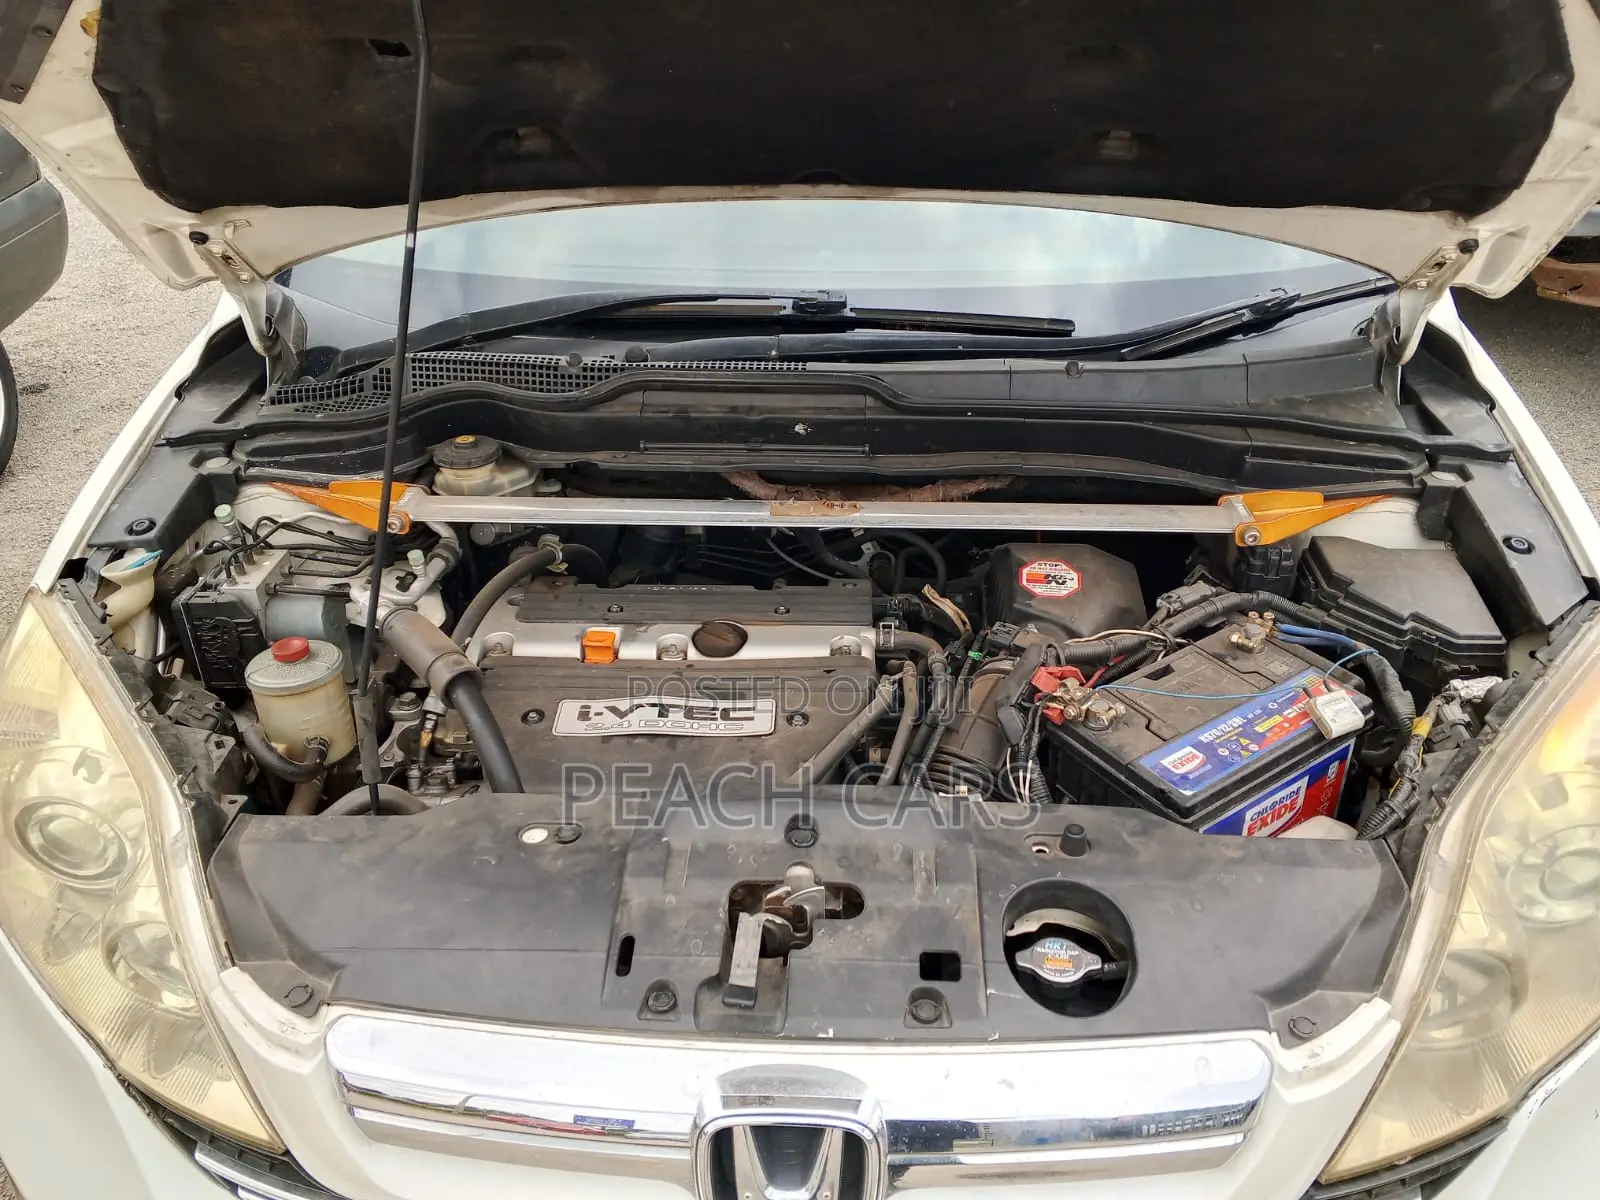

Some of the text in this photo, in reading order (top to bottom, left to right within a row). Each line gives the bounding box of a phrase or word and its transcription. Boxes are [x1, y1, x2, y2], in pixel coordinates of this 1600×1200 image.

[576, 702, 756, 722] i-VTEC
[584, 719, 744, 731] 2.4 DOHC
[1171, 753, 1201, 770] EXIDE
[1250, 785, 1302, 822] CHLORIDE
[1247, 794, 1299, 837] EXIDE
